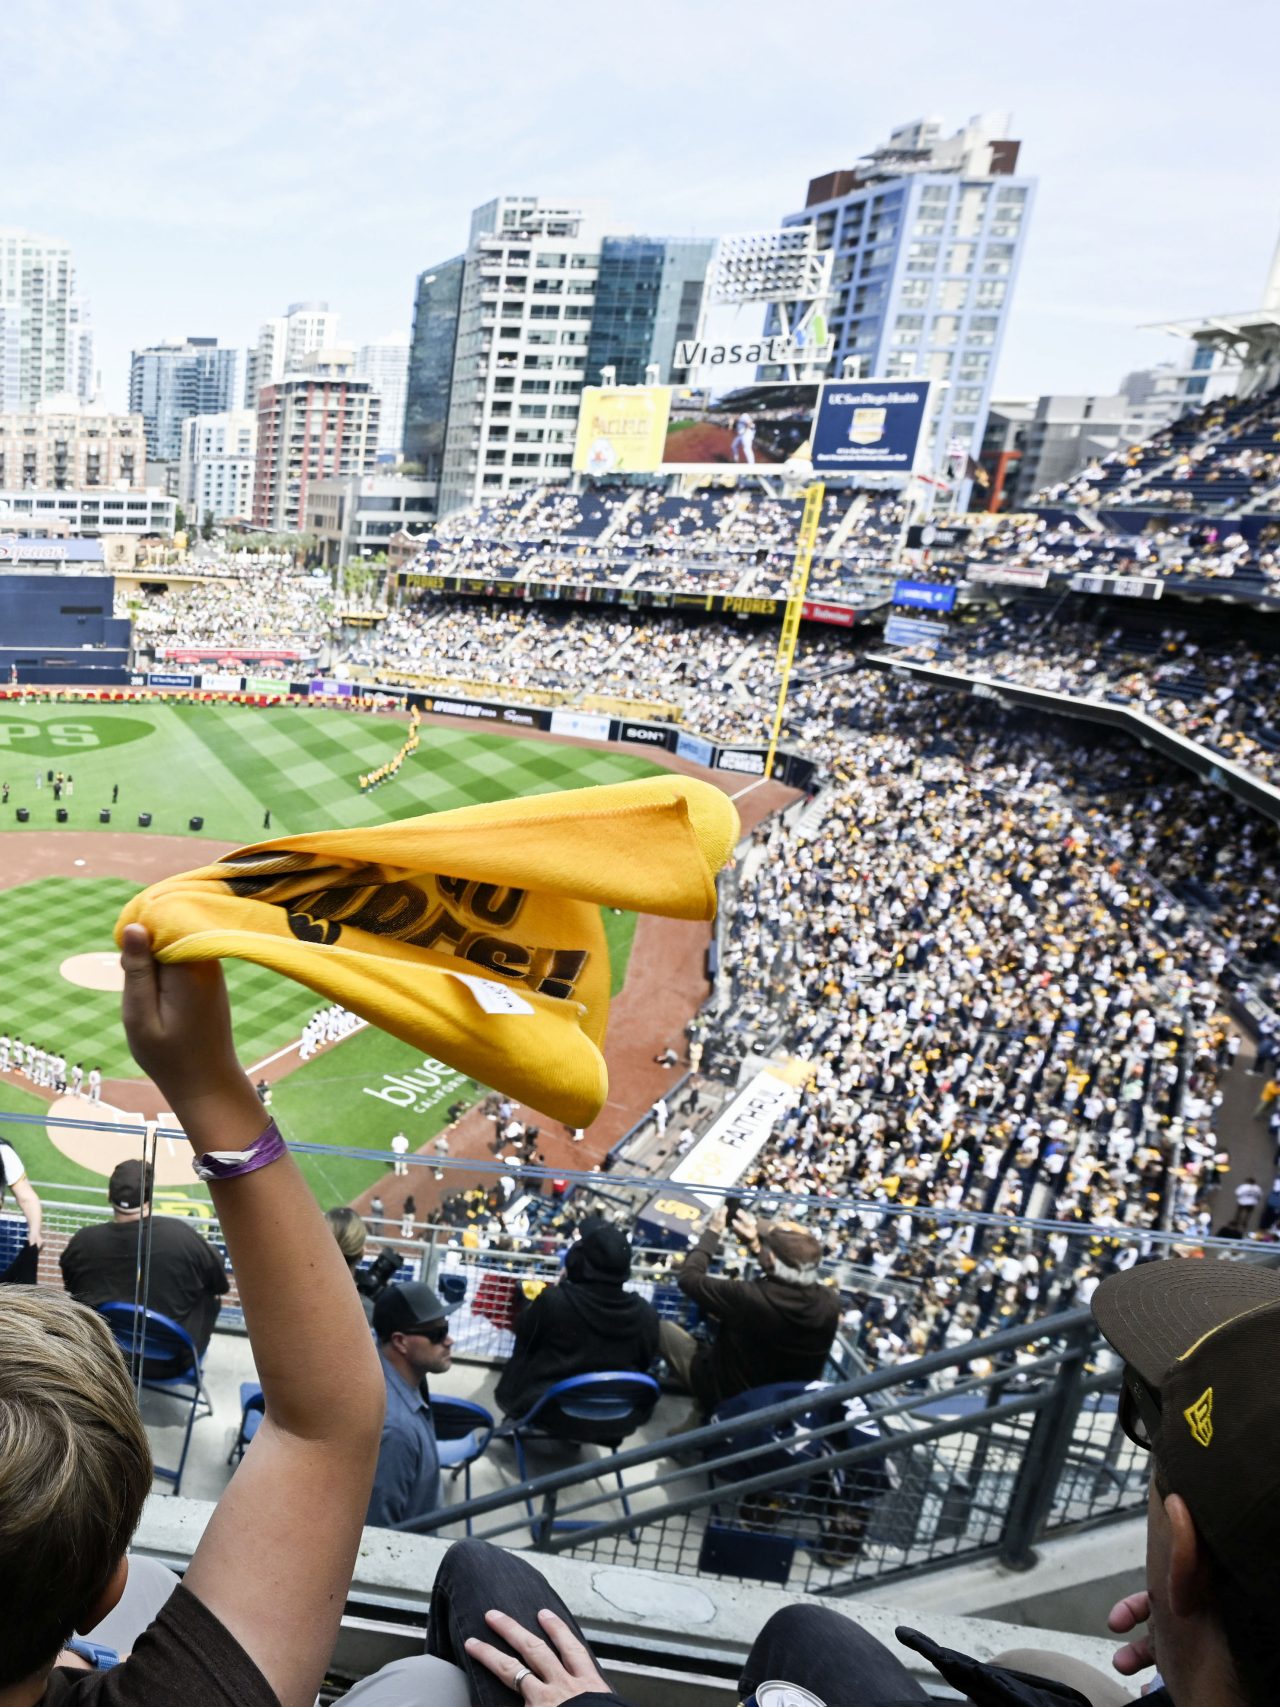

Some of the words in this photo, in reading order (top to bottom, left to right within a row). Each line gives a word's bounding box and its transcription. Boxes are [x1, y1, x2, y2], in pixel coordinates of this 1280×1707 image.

[683, 339, 777, 365] Viasat
[406, 574, 445, 589] PADRES
[722, 592, 777, 614] PADRES
[626, 727, 665, 741] SONY
[362, 1058, 458, 1108] blue
